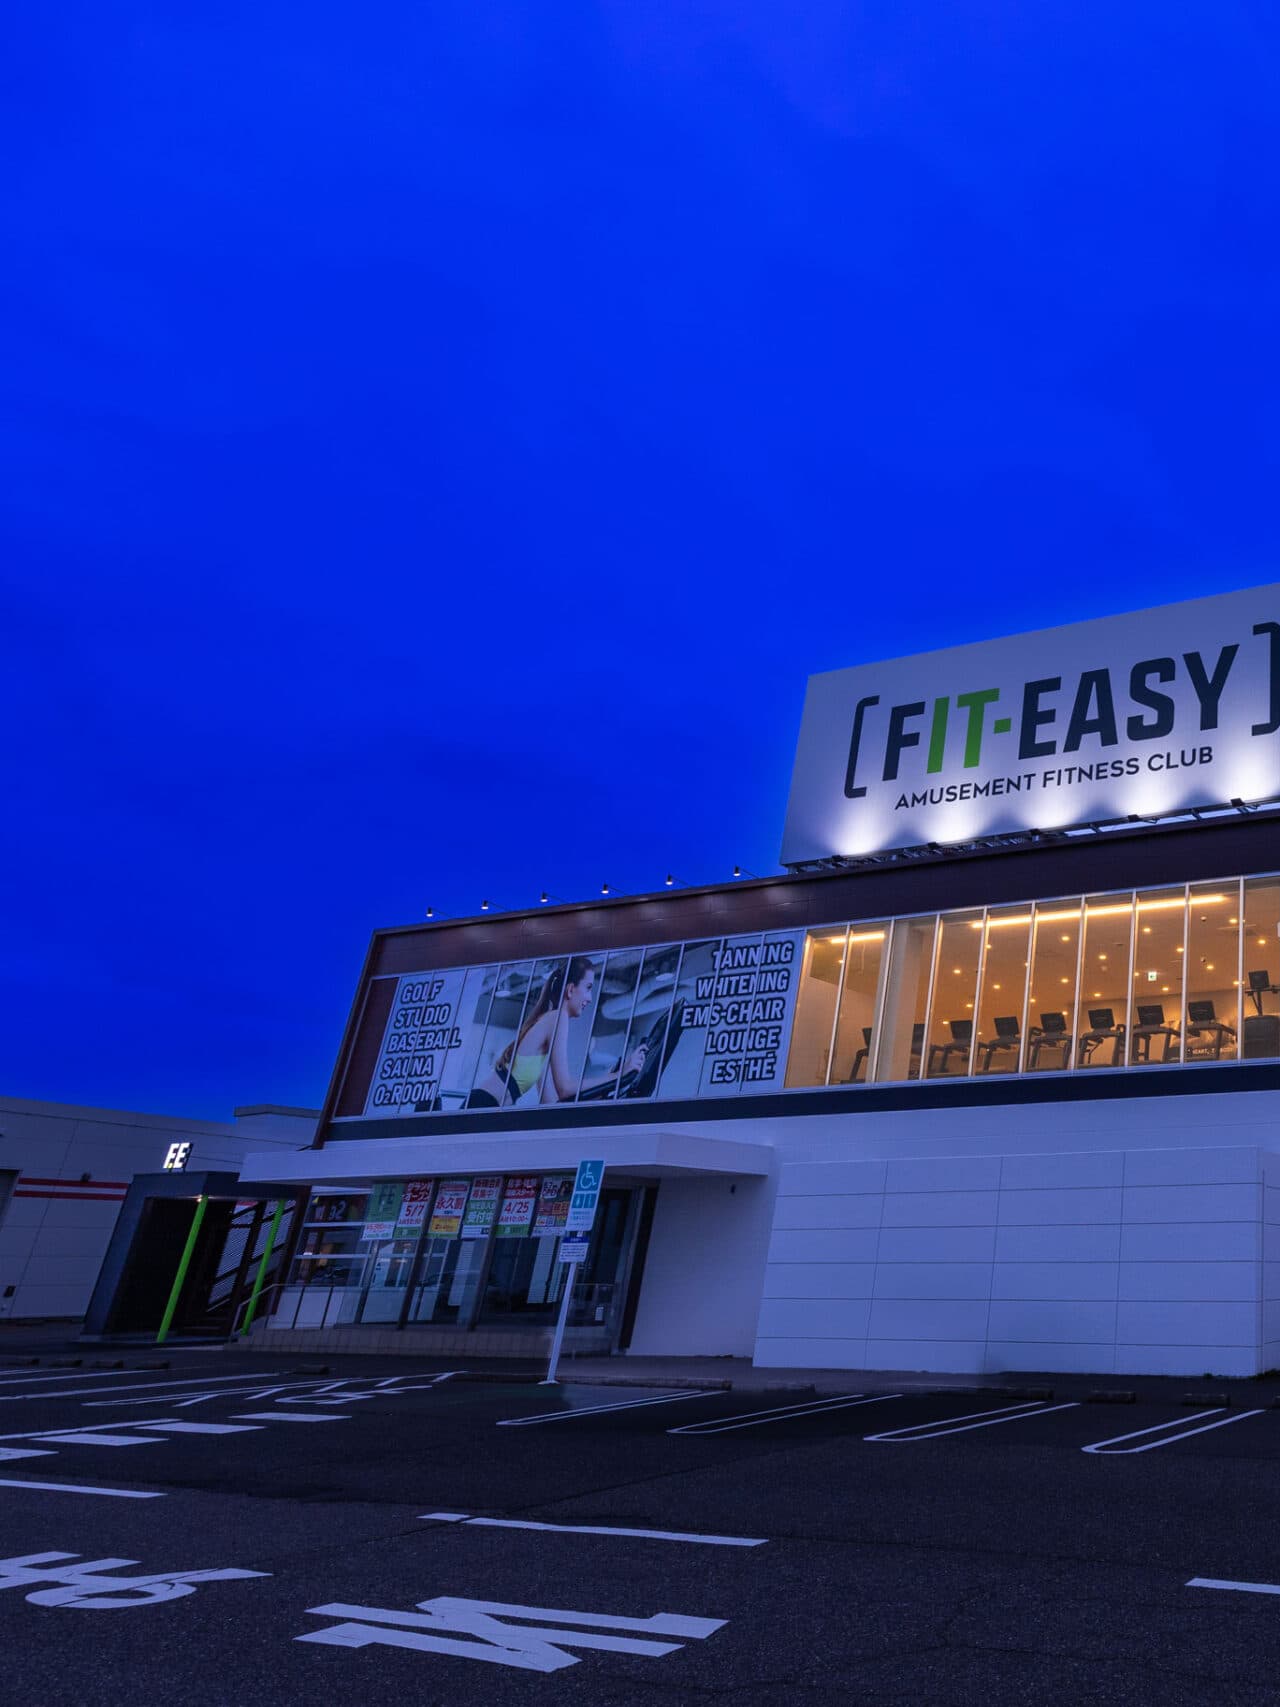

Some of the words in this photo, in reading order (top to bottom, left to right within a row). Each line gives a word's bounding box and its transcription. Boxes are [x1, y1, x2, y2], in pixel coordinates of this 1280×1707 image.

[894, 773, 1036, 810] AMUSEMENT
[1042, 757, 1140, 788] FITNESS
[1147, 746, 1213, 772] CLUB
[712, 941, 794, 972] TANNING
[400, 980, 444, 1004] GOLF
[695, 968, 790, 1000] WHITENING
[394, 1003, 451, 1029] STUDIO
[680, 997, 785, 1029] EMS-CHAIR
[386, 1027, 461, 1054] BASEBALL
[704, 1025, 781, 1055] LOUNGE
[380, 1054, 434, 1080] SAUNA
[405, 1204, 425, 1217] 5/7
[504, 1201, 529, 1214] 4/25
